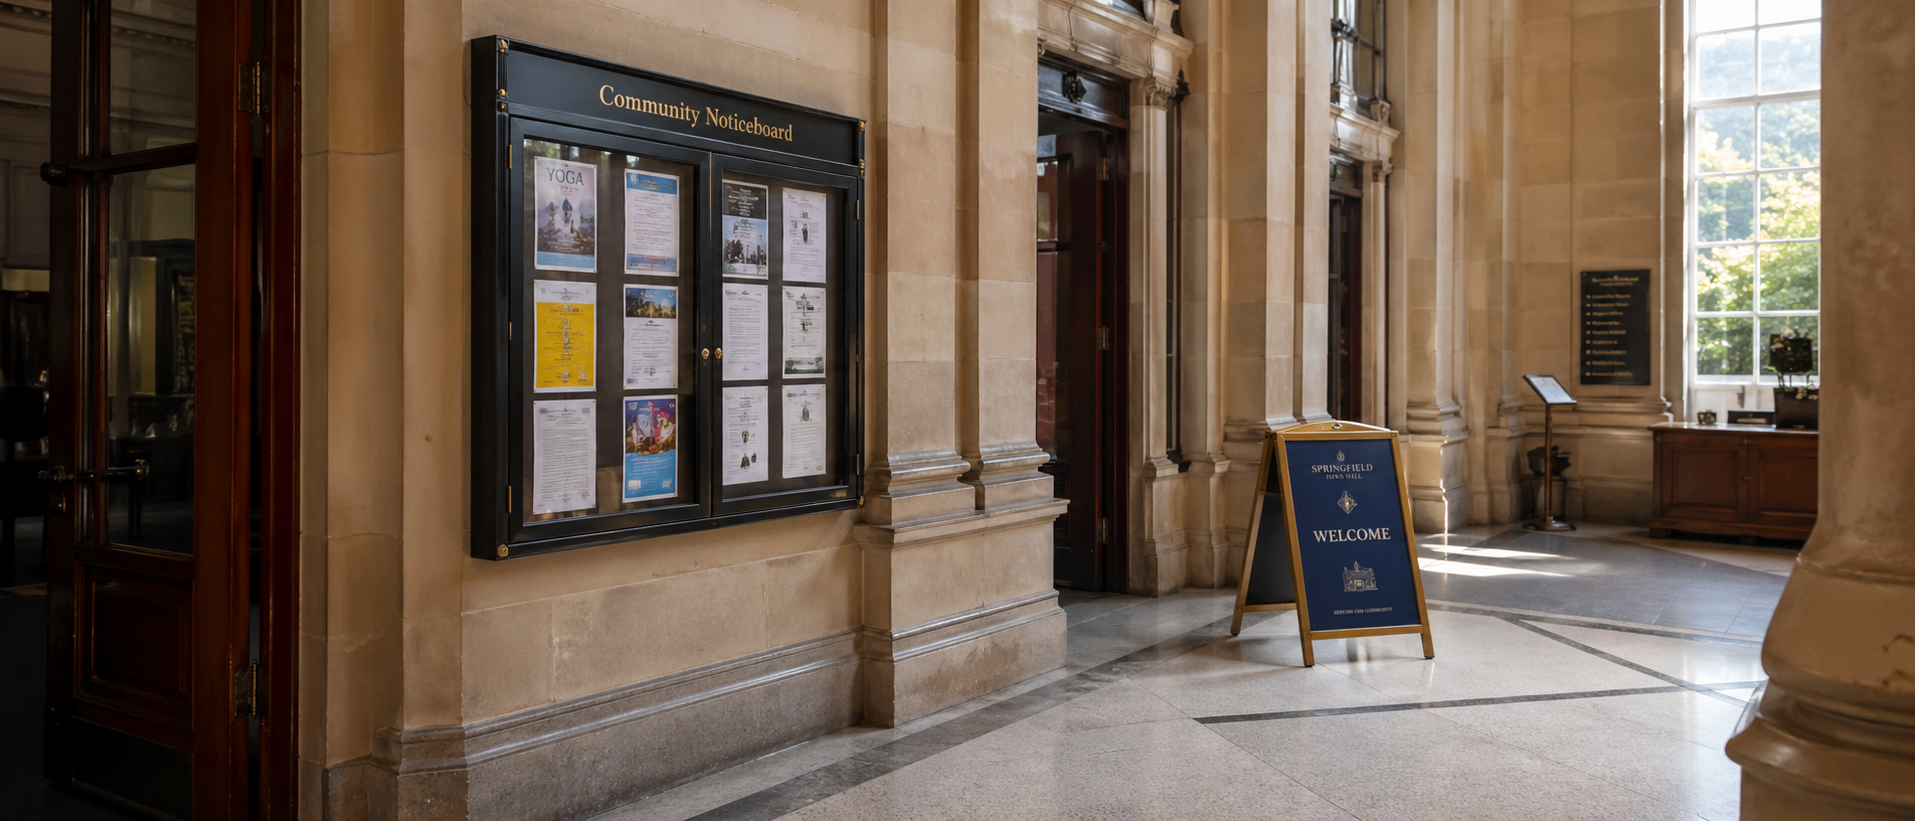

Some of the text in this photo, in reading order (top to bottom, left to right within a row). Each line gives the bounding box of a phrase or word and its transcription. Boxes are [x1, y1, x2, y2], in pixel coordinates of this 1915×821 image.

[599, 84, 793, 142] Community Noticeboard
[546, 167, 584, 186] YOGA
[1311, 463, 1374, 474] SPRINGFIELD
[1313, 528, 1391, 543] WELCOME
